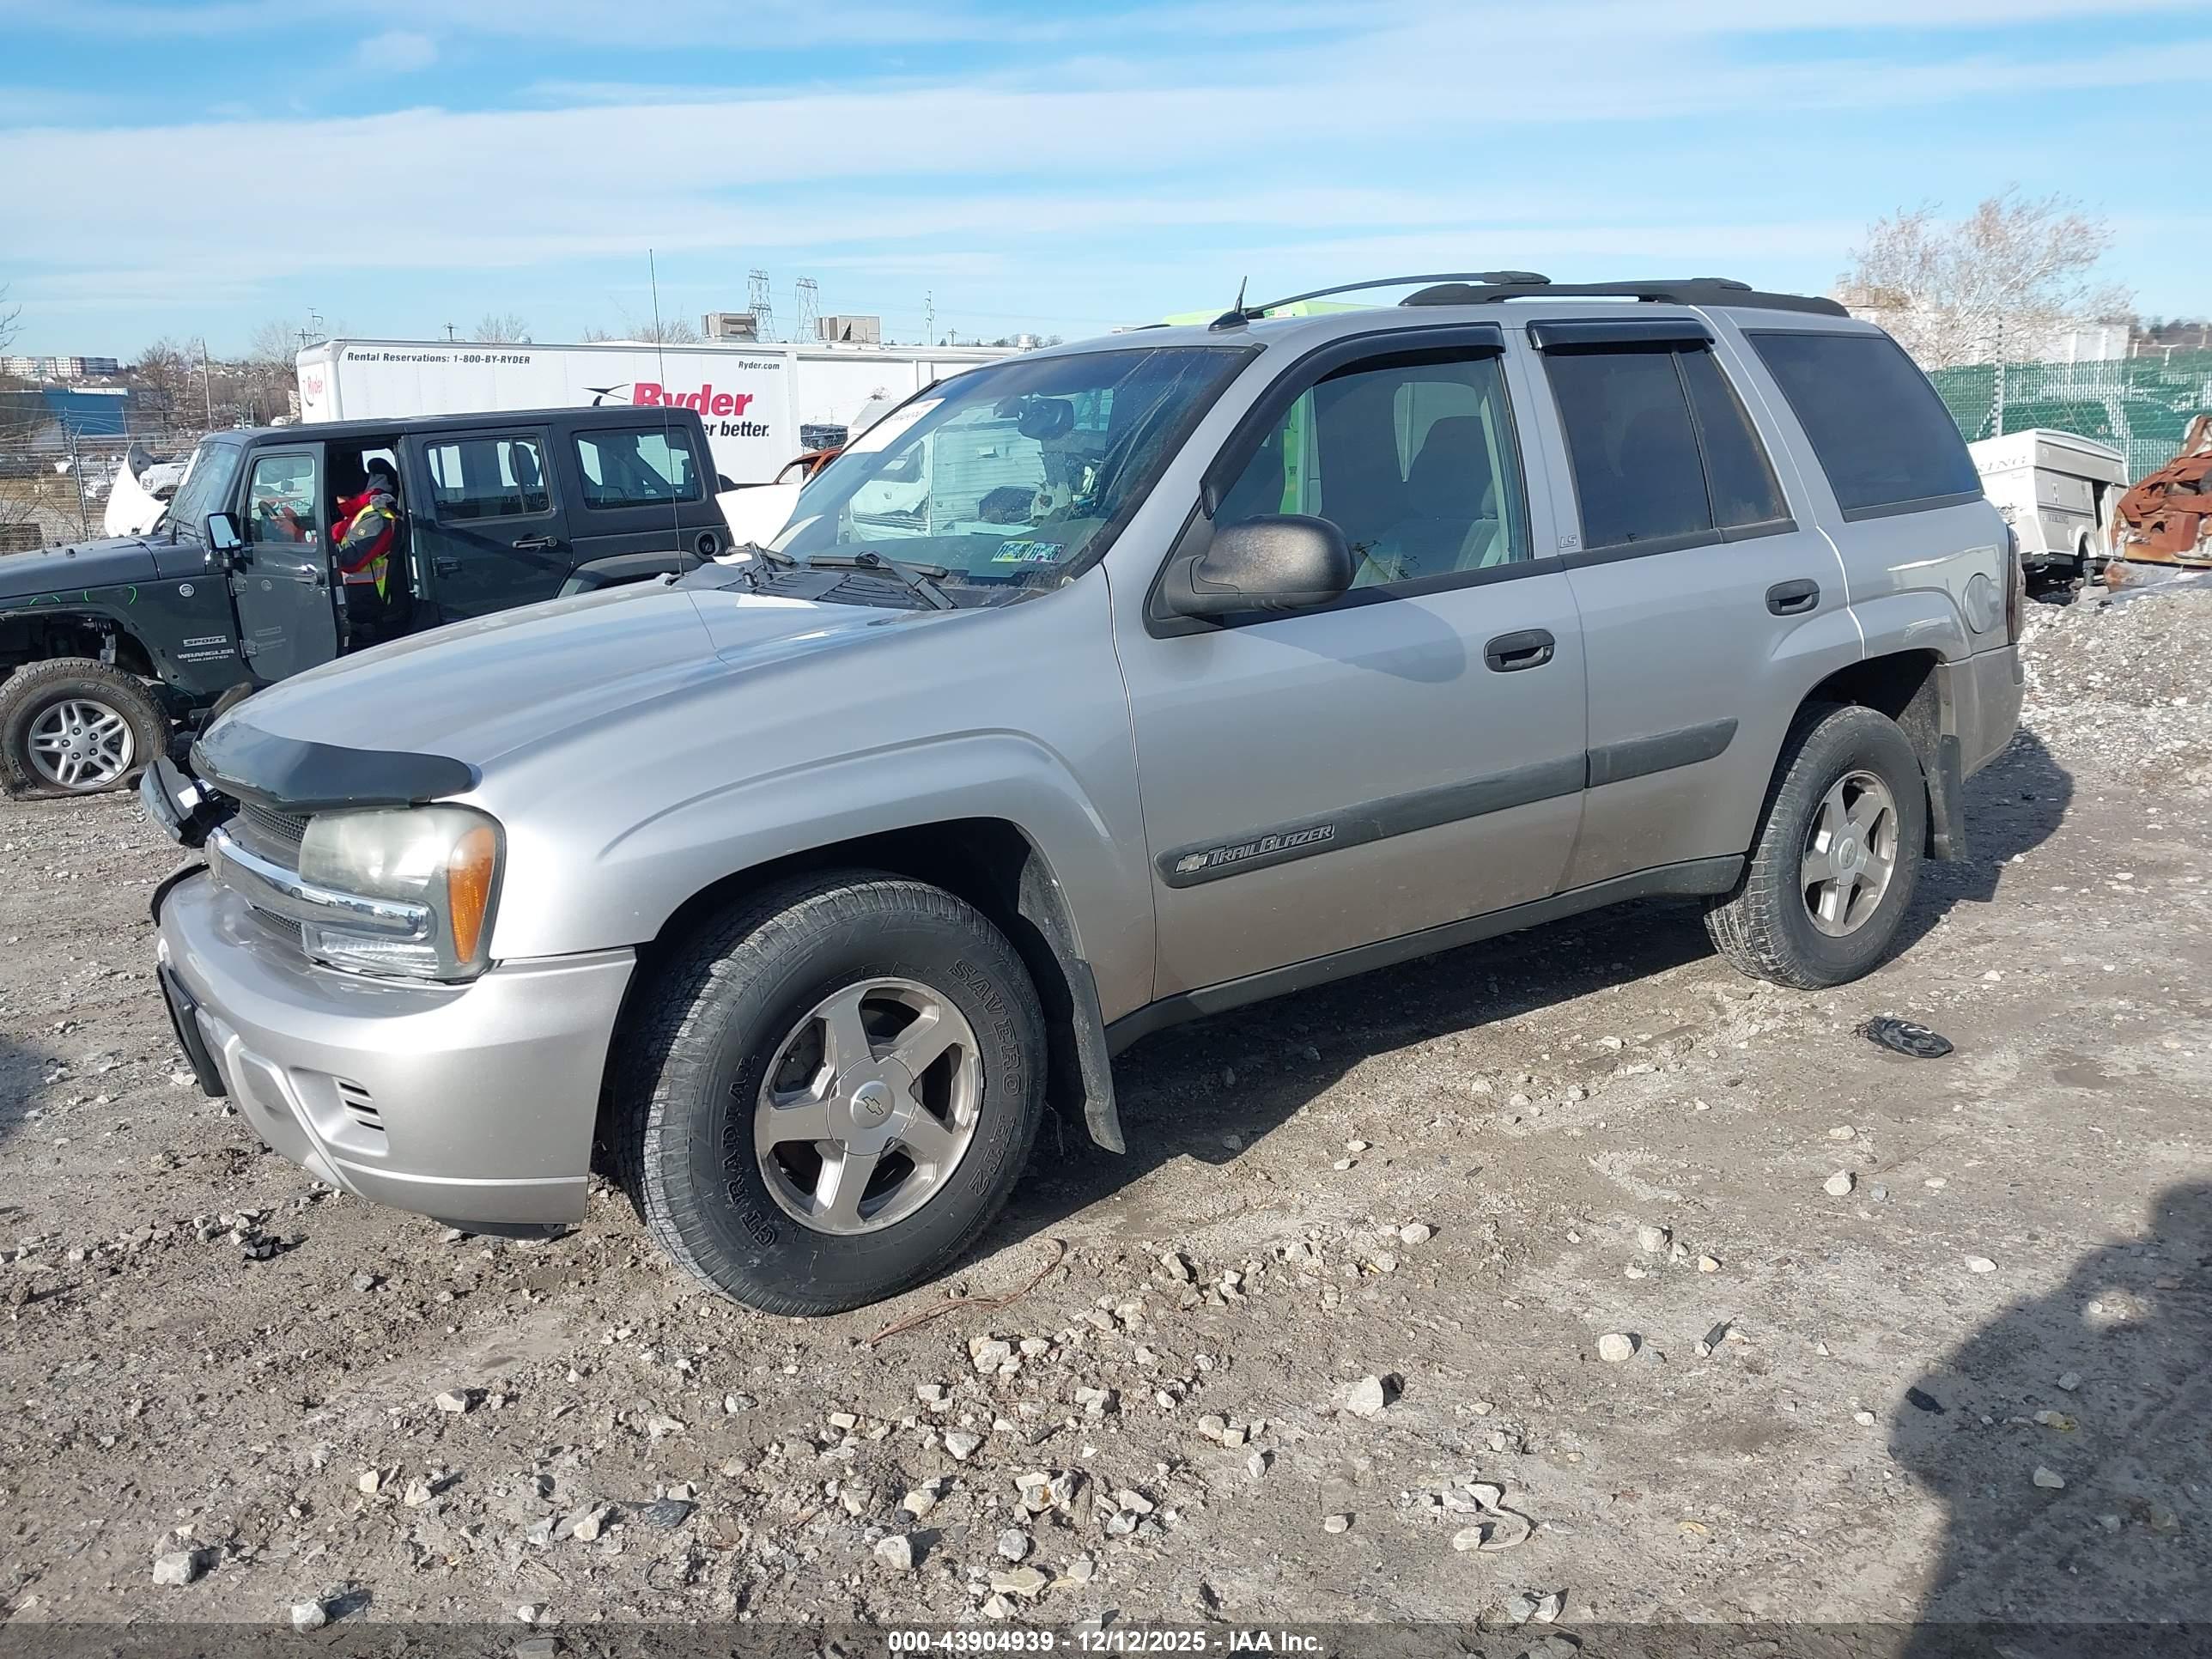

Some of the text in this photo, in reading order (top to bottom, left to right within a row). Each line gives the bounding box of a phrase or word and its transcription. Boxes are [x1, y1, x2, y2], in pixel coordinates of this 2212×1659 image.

[348, 352, 531, 364] Rental Reservations: 1-800-BY-RYDER
[738, 361, 780, 370] Ryder.com
[633, 383, 753, 416] Ryder
[720, 421, 769, 437] better.
[1559, 534, 1577, 548] LS
[184, 635, 227, 647] SPORT
[177, 648, 235, 659] WRANGLER
[187, 654, 229, 663] UNLIMITED
[949, 959, 1022, 1095] SAVERO
[720, 1054, 782, 1248] GT RADIAL
